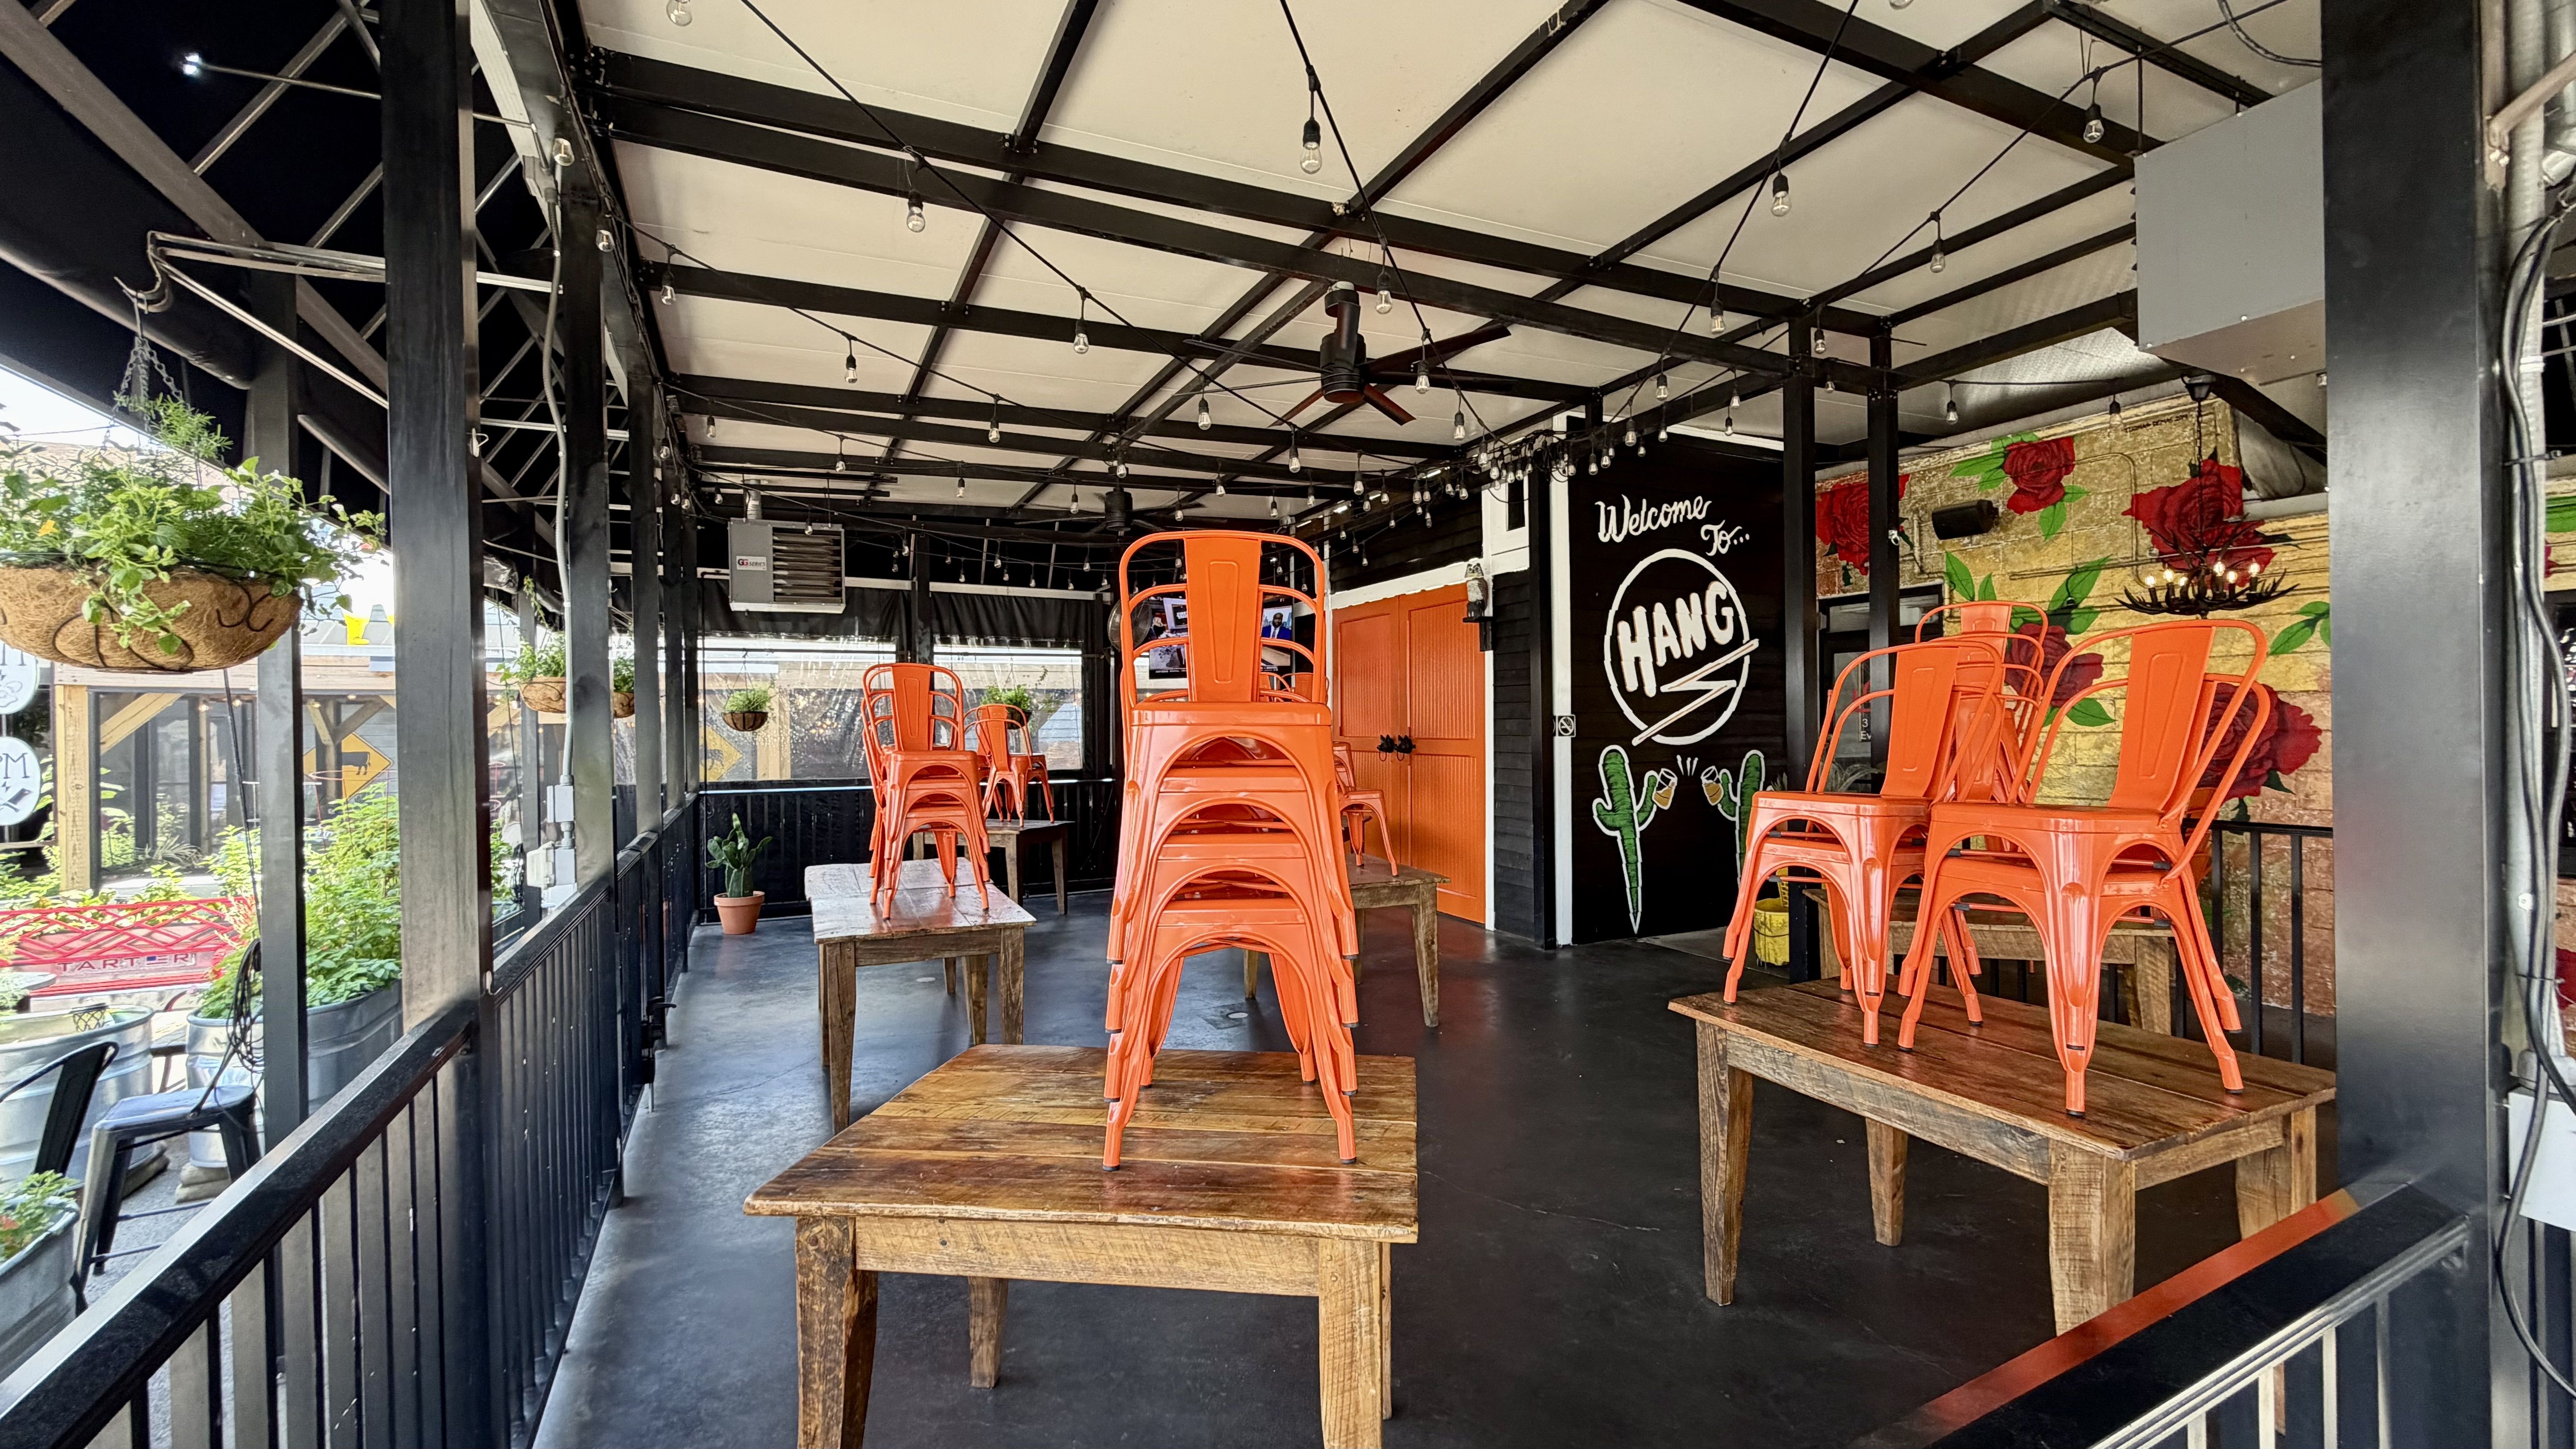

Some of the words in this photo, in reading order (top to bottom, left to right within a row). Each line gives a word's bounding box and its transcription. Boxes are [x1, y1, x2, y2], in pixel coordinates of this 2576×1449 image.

[1594, 494, 1712, 543] Welcome
[1617, 580, 1734, 697] HANG
[1862, 718, 1868, 727] 3
[57, 953, 189, 972] TARTER
